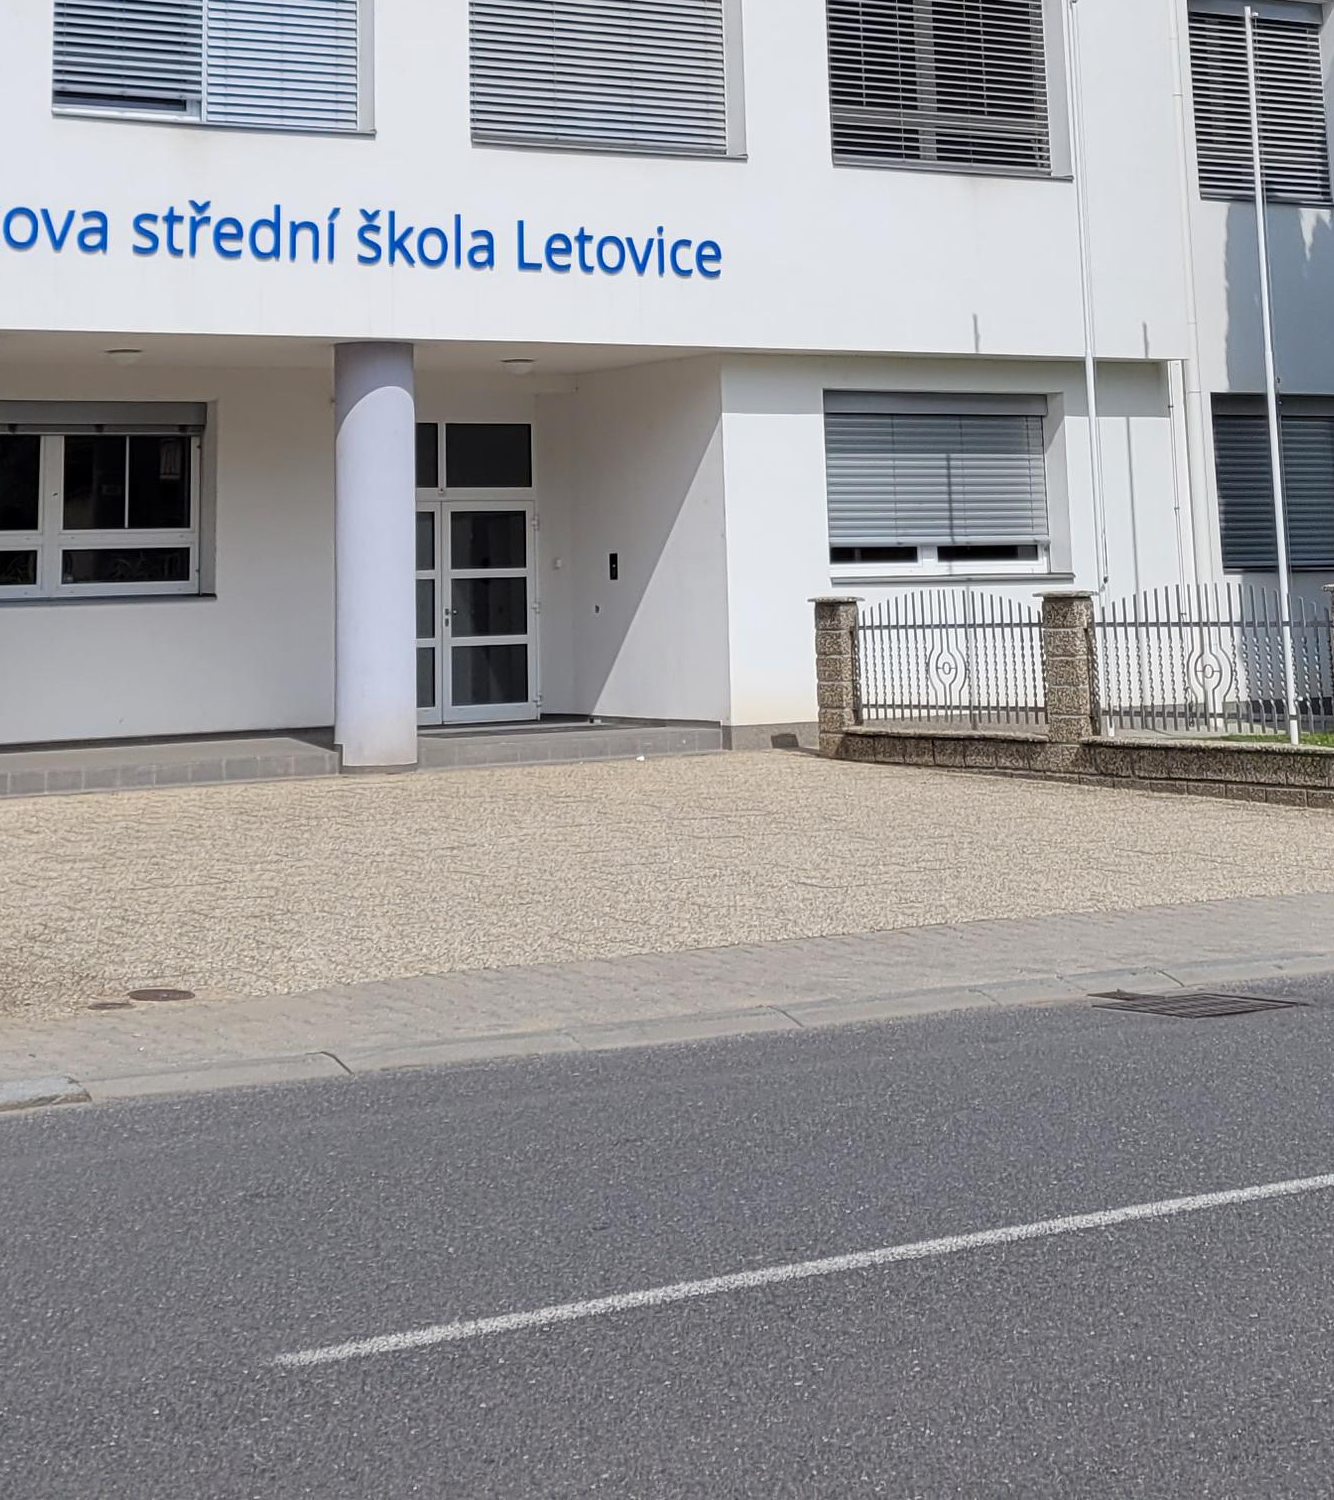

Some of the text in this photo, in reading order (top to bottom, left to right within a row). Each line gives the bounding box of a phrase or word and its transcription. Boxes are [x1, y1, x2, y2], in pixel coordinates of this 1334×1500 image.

[132, 199, 341, 261] střední
[357, 205, 496, 269] škola
[516, 219, 723, 278] Letovice
